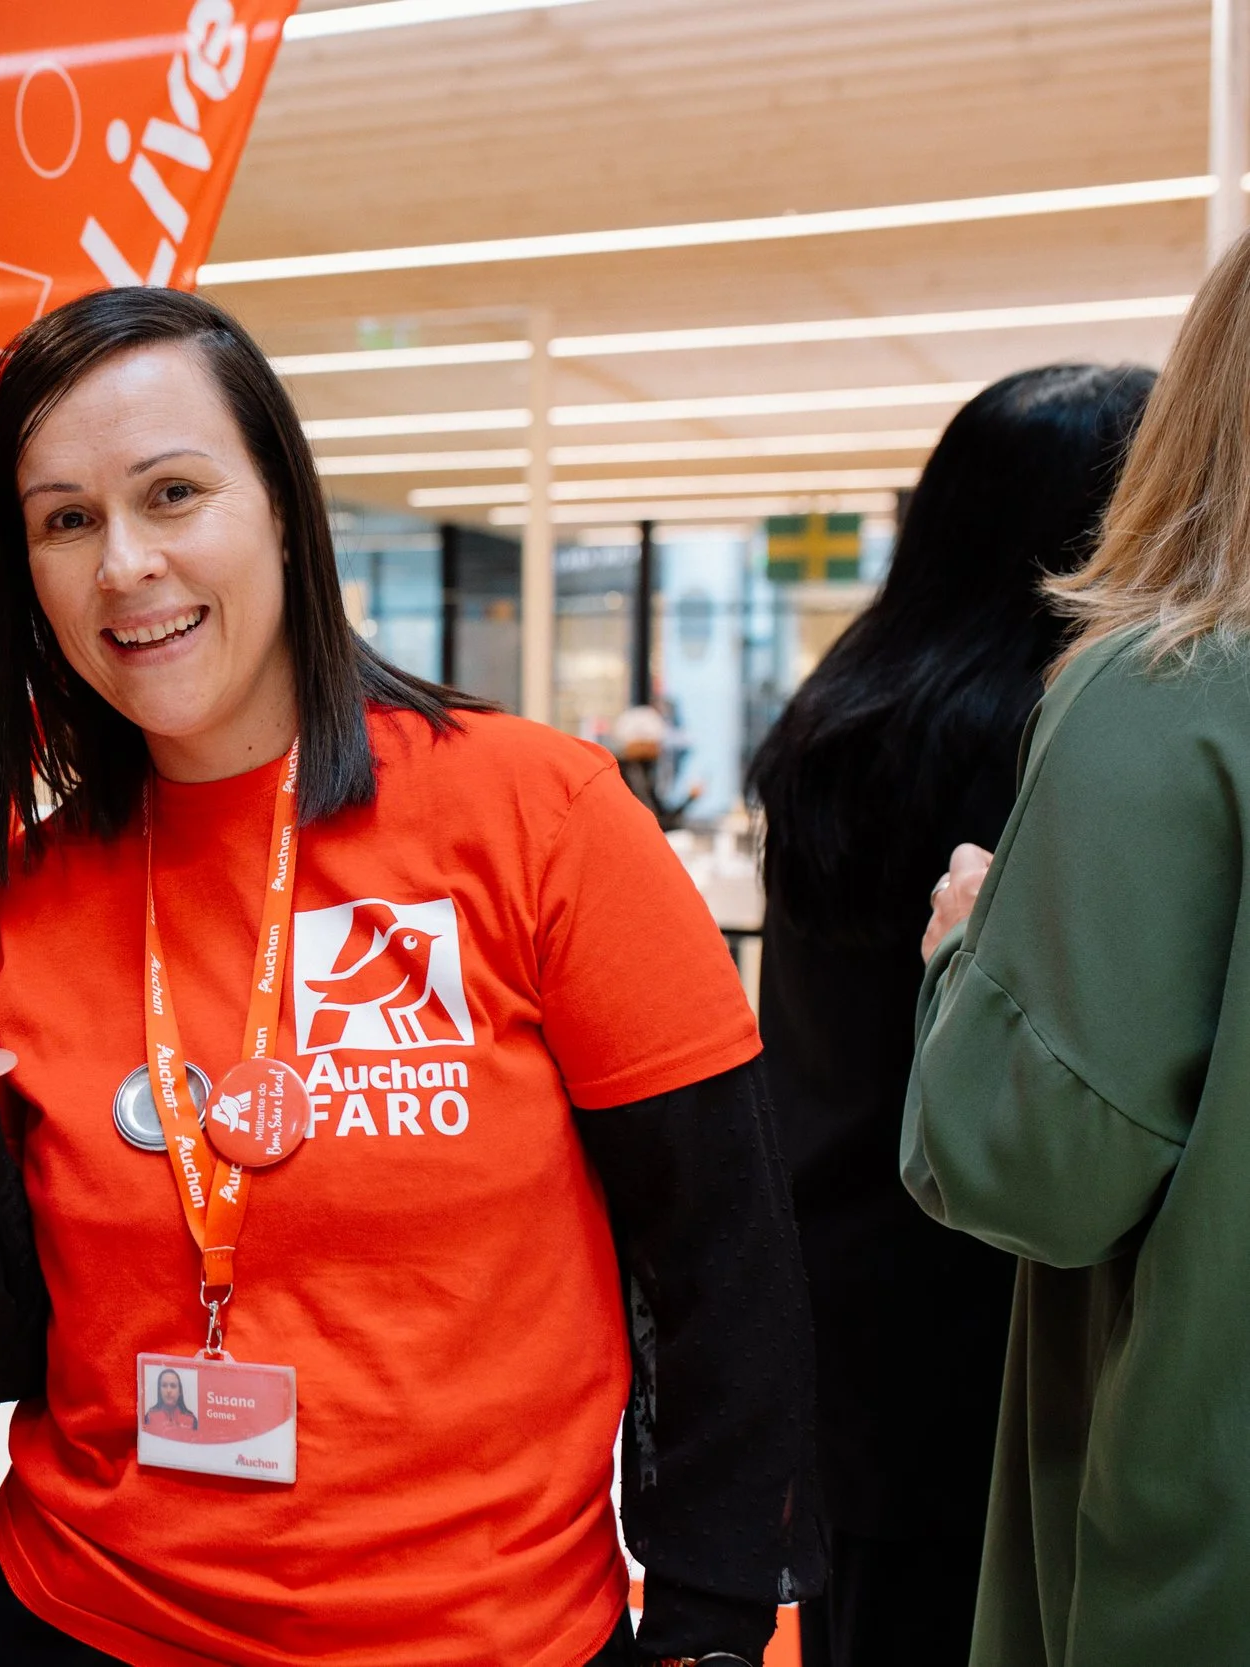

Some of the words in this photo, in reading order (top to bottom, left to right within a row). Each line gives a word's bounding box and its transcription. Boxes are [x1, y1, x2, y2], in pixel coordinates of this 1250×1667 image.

[79, 0, 249, 289] Live
[271, 825, 292, 892] Auchan
[258, 924, 280, 994] Auchan
[150, 951, 164, 1016] Auchan
[251, 1026, 269, 1059] han
[156, 1043, 180, 1109] Auchan
[259, 1082, 267, 1096] do
[305, 1052, 469, 1093] Auchan
[255, 1098, 266, 1141] Militante
[303, 1089, 470, 1140] FARO
[175, 1135, 206, 1209] Auchan
[219, 1163, 243, 1205] Auc
[206, 1391, 256, 1408] Susana
[206, 1408, 237, 1421] Gomes
[235, 1453, 279, 1470] Auchan
